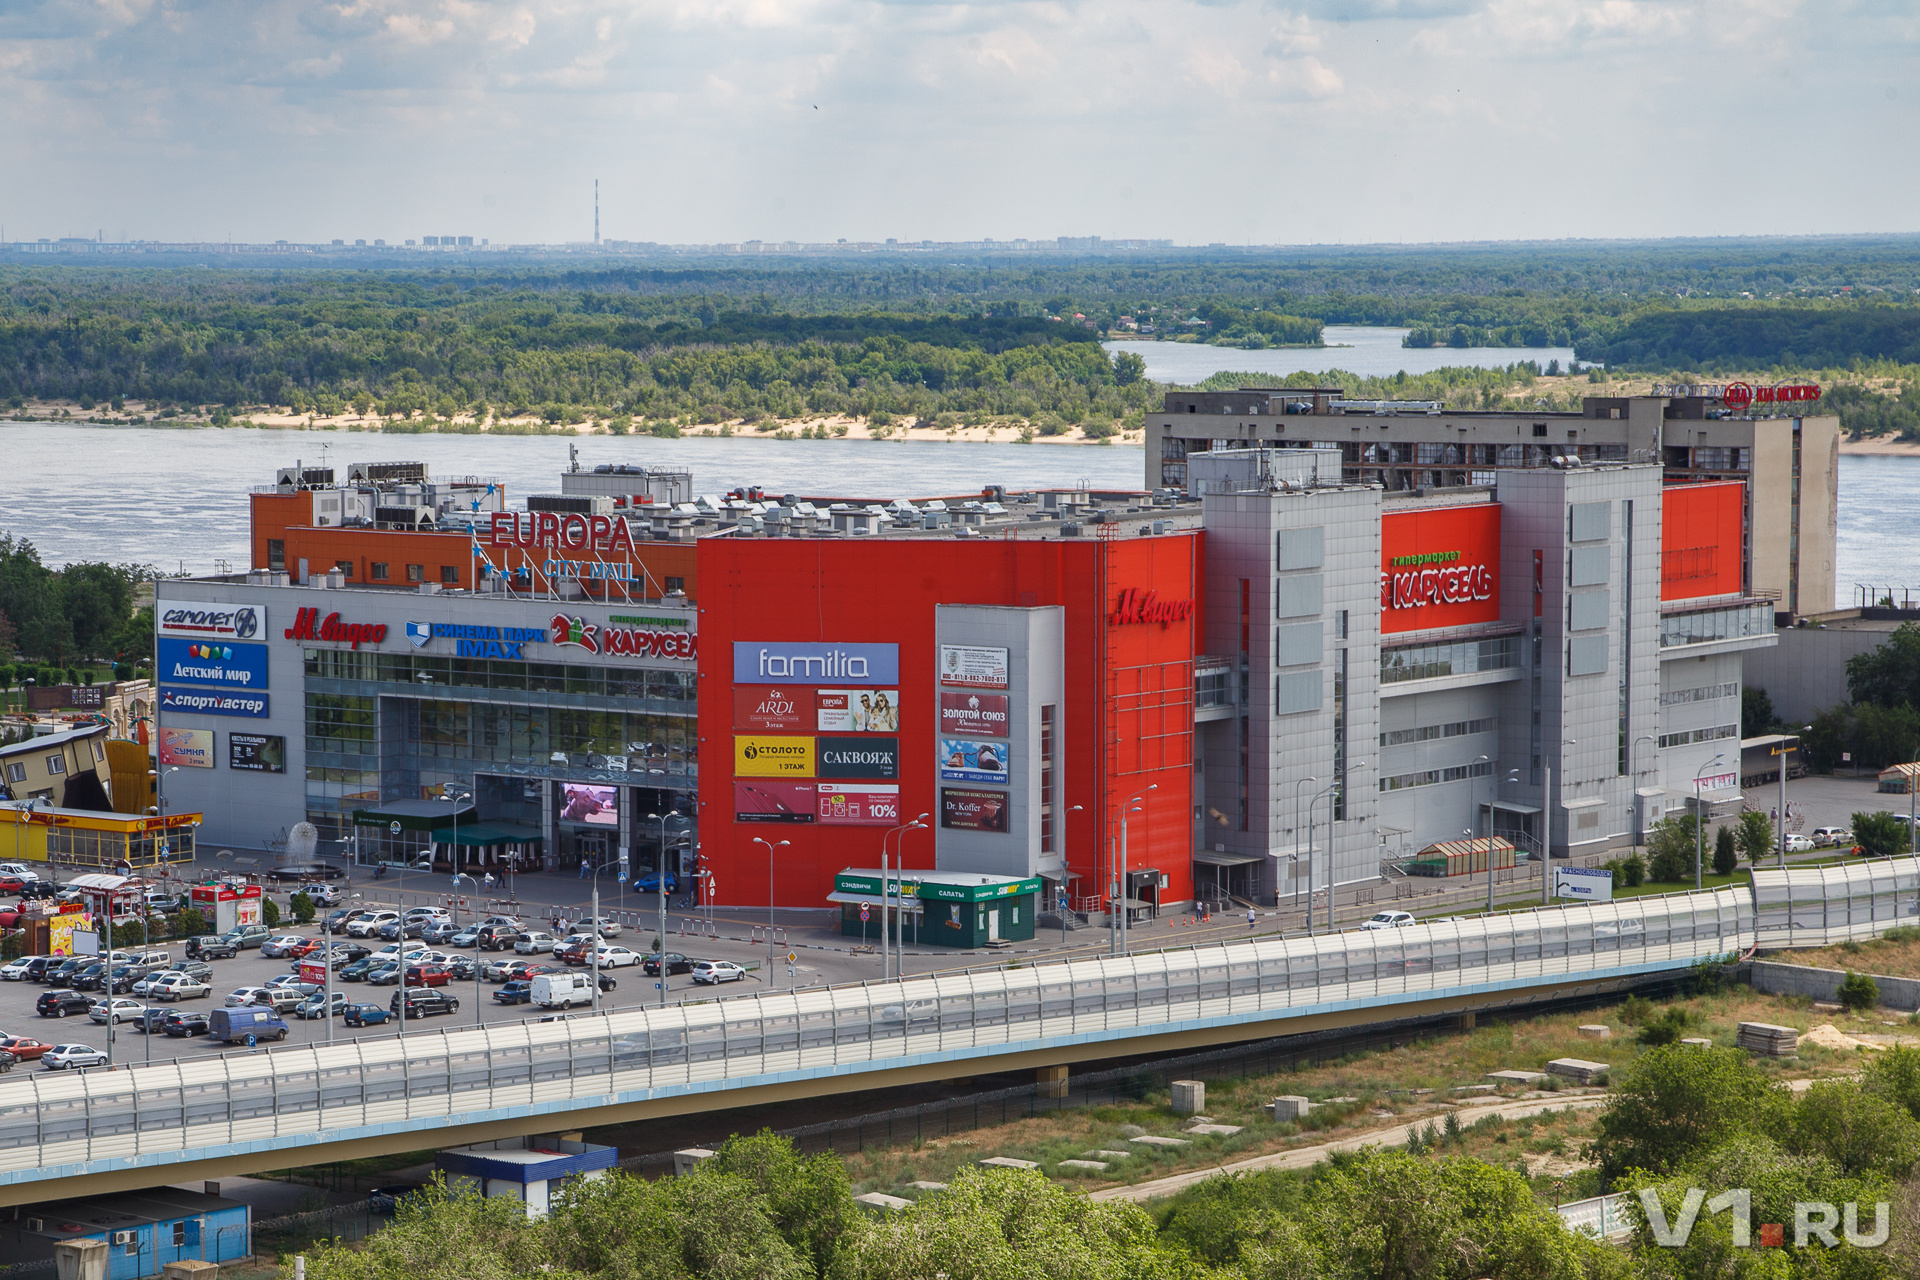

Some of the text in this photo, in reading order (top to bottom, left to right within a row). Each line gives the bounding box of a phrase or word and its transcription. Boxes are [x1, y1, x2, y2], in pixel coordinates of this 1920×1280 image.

[1756, 387, 1775, 402] KIA
[1776, 385, 1821, 402] MOTORS
[491, 512, 635, 554] EUROPA
[1393, 551, 1461, 566] гипермаркет
[543, 560, 639, 581] CITY MALL
[1393, 564, 1493, 610] КАРУСЕЛЬ
[609, 614, 688, 627] гипермаркет
[284, 607, 386, 650] М.видео
[433, 623, 546, 643] СИНЕМА ПАРК
[456, 640, 522, 660] IMAX
[759, 648, 869, 678] familia
[173, 662, 251, 685] Детский мир
[756, 700, 794, 716] ARDI
[943, 708, 1006, 721] ЗОЛОТОЙ СОЮЗ
[759, 746, 805, 754] СТОЛОТО
[823, 751, 893, 764] САКВОЯЖ
[868, 804, 896, 817] 10%
[946, 801, 981, 812] Dr. Koffer
[1562, 868, 1611, 877] КРАСНОСЛОБОДСК
[841, 881, 871, 890] СЭНДВИЧИ
[997, 884, 1019, 896] SUBWAY
[938, 890, 965, 898] САЛАТЫ
